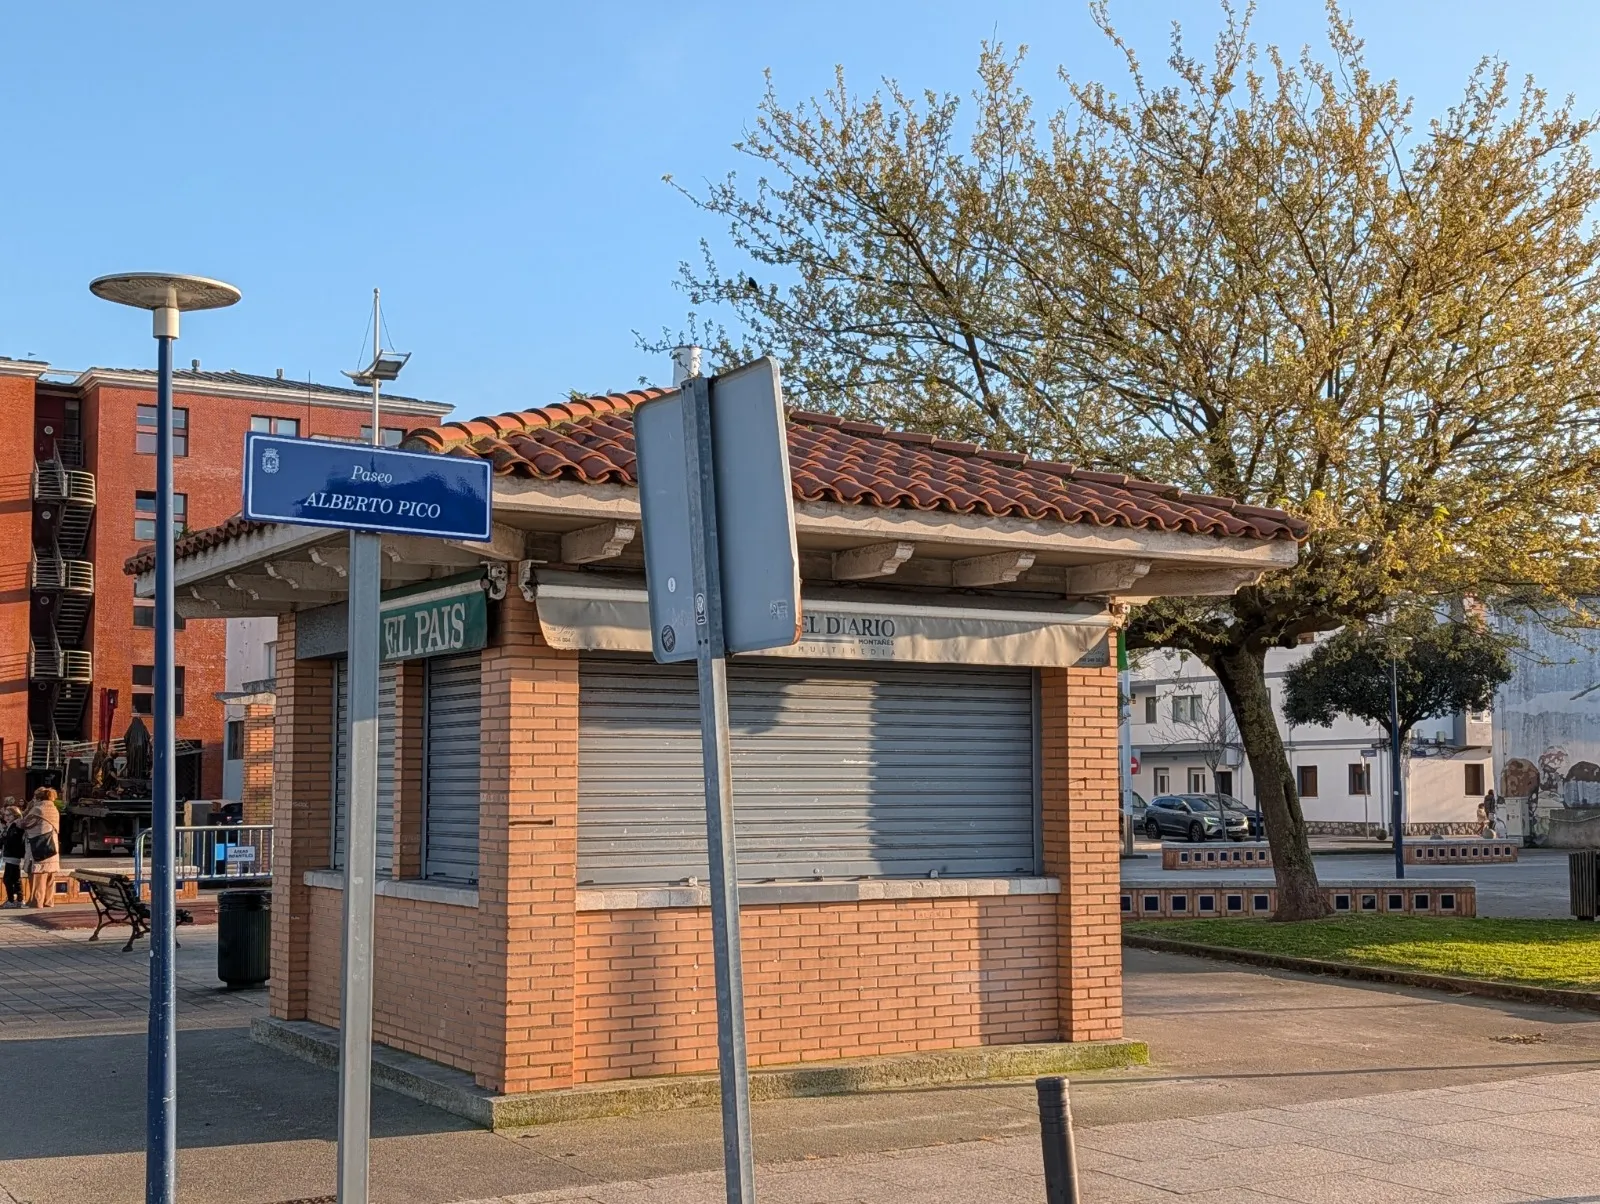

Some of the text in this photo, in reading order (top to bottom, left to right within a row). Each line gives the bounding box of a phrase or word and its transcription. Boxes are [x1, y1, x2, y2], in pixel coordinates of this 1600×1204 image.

[351, 465, 393, 484] Paseo
[303, 492, 441, 519] ALBERTO PICO
[384, 602, 466, 660] EL PAIS
[826, 616, 895, 637] DIARIO
[798, 646, 896, 656] MULTIMEDIA
